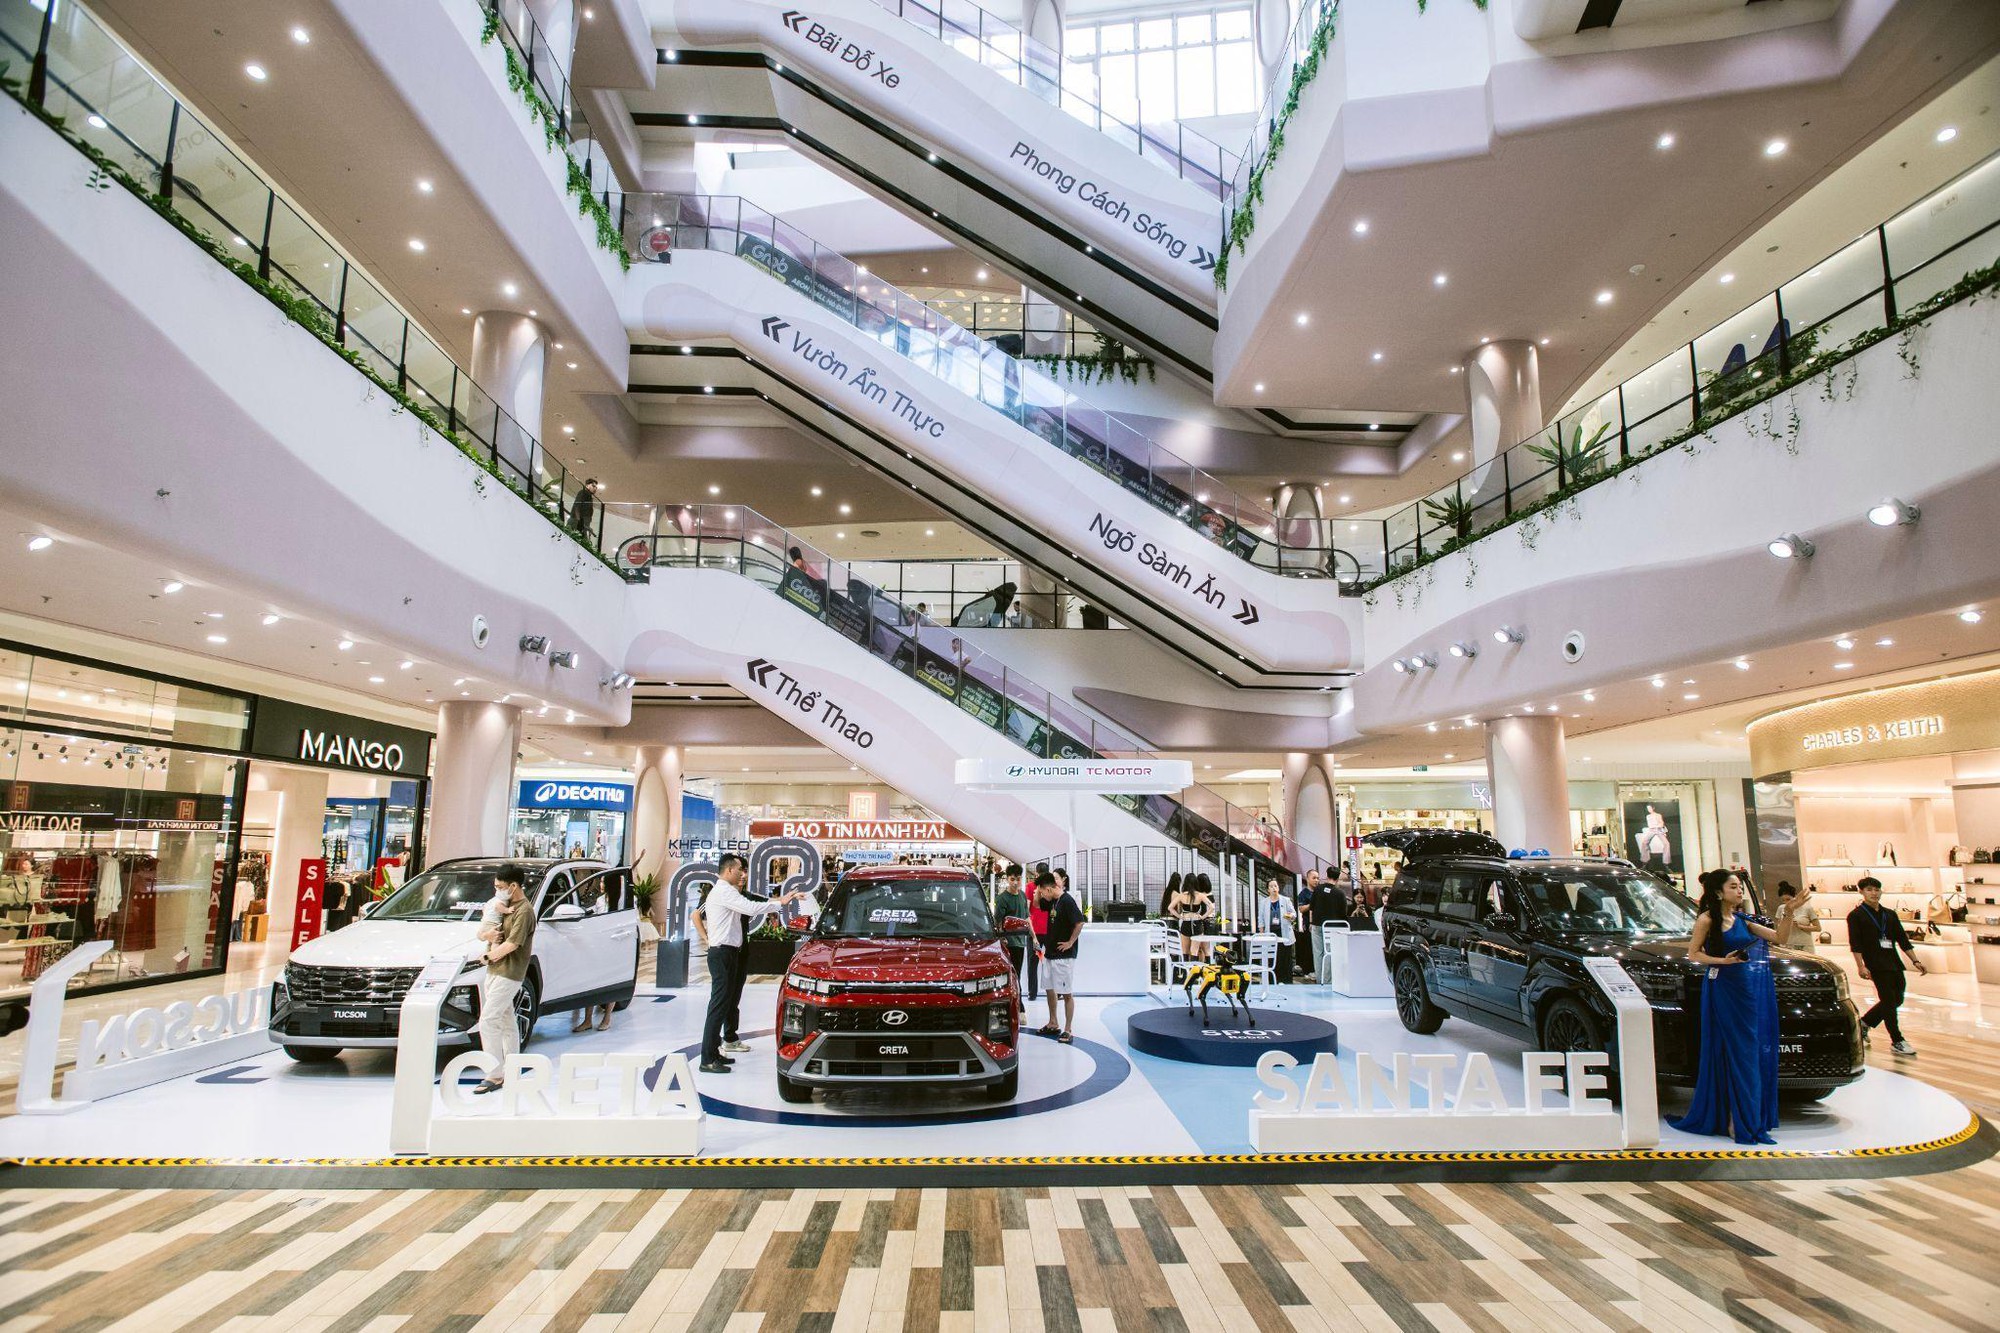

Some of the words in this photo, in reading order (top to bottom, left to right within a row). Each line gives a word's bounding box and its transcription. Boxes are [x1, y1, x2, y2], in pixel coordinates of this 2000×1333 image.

[805, 22, 842, 53] Bãi
[840, 43, 875, 71] Đỗ
[871, 60, 900, 88] Xe
[1010, 141, 1076, 194] Phong
[1078, 182, 1131, 223] Cách
[1132, 213, 1187, 259] Sống
[751, 244, 789, 274] Grab
[792, 331, 849, 381] Vườn
[848, 367, 888, 404] Ẩm
[891, 391, 945, 438] Thực
[1089, 512, 1137, 552] Ngõ
[1137, 543, 1192, 589] Sành
[1192, 573, 1226, 609] Ăn
[790, 579, 822, 603] Grab
[925, 661, 956, 687] Grab
[775, 672, 822, 712] Thể
[821, 700, 874, 748] Thao
[1802, 727, 1862, 750] CHARLES
[1866, 725, 1880, 742] &
[1884, 716, 1943, 739] KEITH
[301, 729, 403, 772] MANGO
[1028, 767, 1079, 776] HYUNDAI
[1086, 767, 1102, 776] TC
[1105, 767, 1152, 776] MOTOR
[558, 785, 625, 803] DECATHLON
[1471, 782, 1492, 809] LYN
[668, 836, 713, 850] KHÉO
[718, 836, 750, 850] LÉO
[205, 868, 225, 960] SALE
[298, 865, 318, 945] SALE
[871, 908, 917, 918] CRETA
[334, 1010, 367, 1019] TUCSON
[879, 1046, 909, 1055] CRETA
[1791, 1044, 1803, 1053] FE
[439, 1050, 703, 1117] CRETA
[1252, 1050, 1510, 1115] SANTA
[1521, 1051, 1614, 1115] FE
